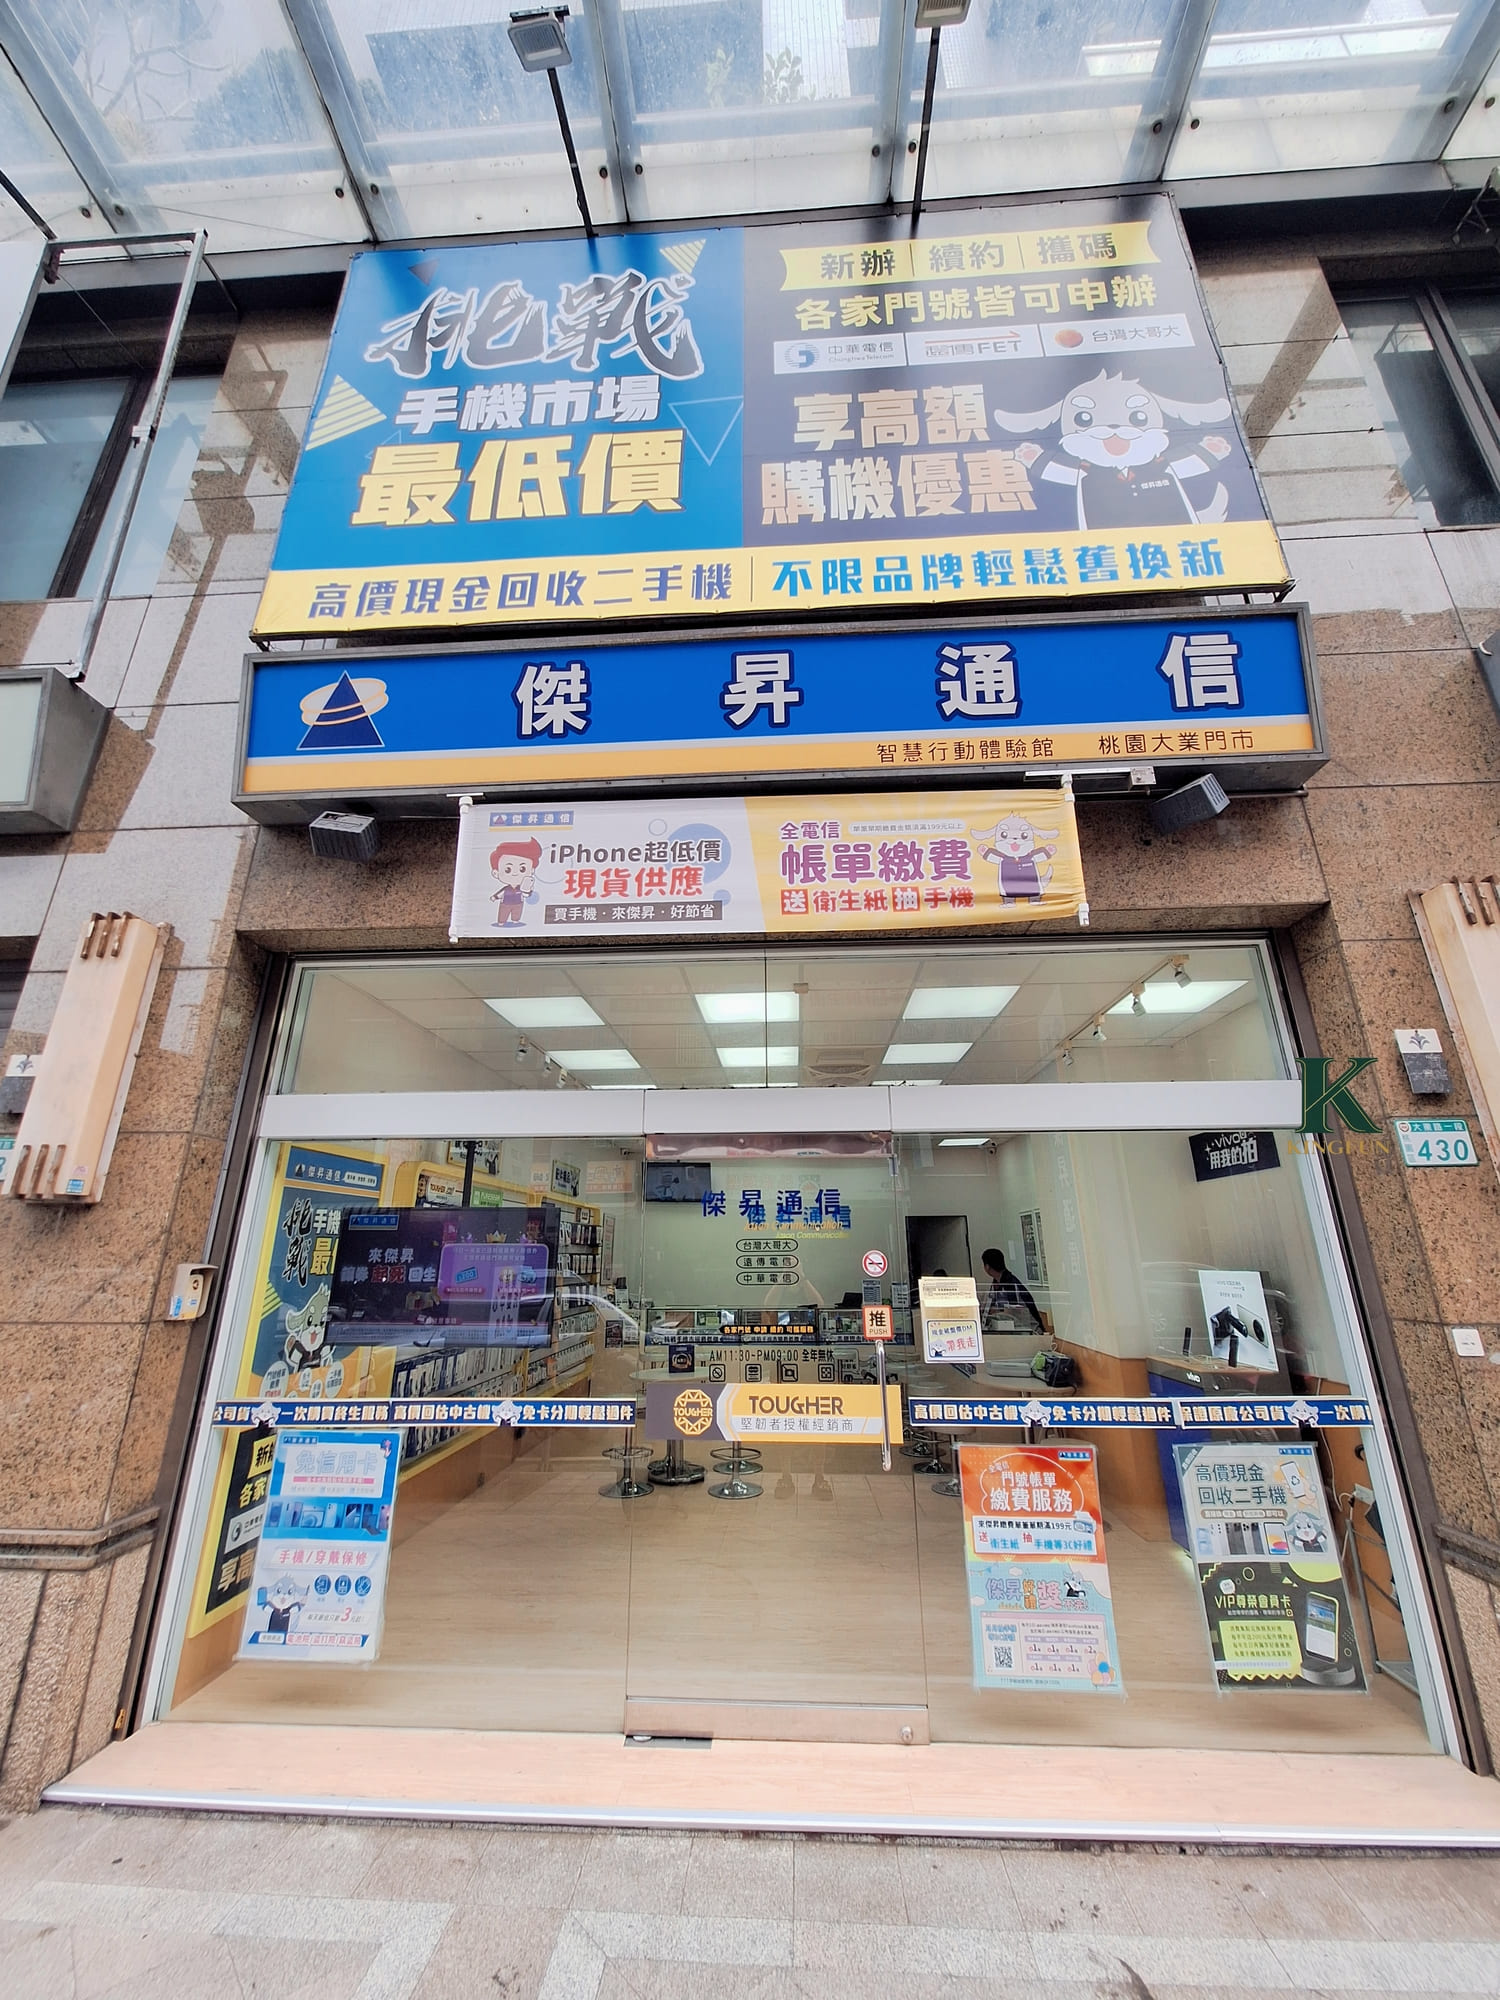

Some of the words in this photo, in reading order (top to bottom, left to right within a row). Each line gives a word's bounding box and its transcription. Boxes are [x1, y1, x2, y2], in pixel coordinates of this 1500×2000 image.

[820, 249, 896, 280] 新辦
[929, 240, 1004, 272] 續約
[1038, 232, 1116, 263] 攜碼
[795, 275, 1157, 331] 各家門號皆可申辦
[364, 268, 704, 380] 挑戰
[828, 342, 893, 355] 中華電信
[978, 340, 1021, 354] FET
[1092, 325, 1181, 344] 台灣大哥大
[395, 375, 660, 435] 手機市場
[794, 384, 990, 451] 享高額
[351, 429, 685, 527] 最低價
[761, 448, 1038, 525] 購機優惠
[308, 563, 733, 618] 高價現金回收二手機
[772, 539, 1226, 597] 不限品牌輕鬆舊換新
[516, 633, 1241, 735] 傑昇通信
[876, 737, 1055, 763] 智慧行動體驗館
[1098, 729, 1255, 754] 桃園大業門市
[512, 813, 570, 825] 傑昇通信
[780, 821, 840, 840] 全電信
[550, 839, 721, 864] iPhone超低價
[781, 839, 972, 884] 帳單繳費
[563, 867, 704, 899] 現貨供應
[1213, 1134, 1240, 1148] vivo
[1418, 1139, 1469, 1161] 430
[700, 1189, 840, 1217] 傑昇通信
[313, 1209, 341, 1234] 手機
[282, 1197, 313, 1287] 挑戰
[743, 1241, 791, 1250] 台灣大哥大
[743, 1257, 792, 1267] 遠傳電信
[743, 1274, 792, 1284] 中華電信
[869, 1310, 886, 1327] 推
[710, 1350, 799, 1362] AM11:30-PM09:00
[801, 1349, 835, 1362] 全年無休
[674, 1408, 712, 1417] TOUGHER
[749, 1396, 844, 1415] TOUGHER
[1320, 1405, 1371, 1421] 一次購
[741, 1418, 853, 1431] 堅韌者授權經銷商
[295, 1450, 377, 1475] 免信用卡
[1195, 1464, 1265, 1482] 高價現金
[1001, 1472, 1056, 1487] 門號帳單
[239, 1477, 267, 1508] 各家
[990, 1488, 1072, 1512] 繳費服務
[1199, 1486, 1287, 1505] 回收二手機
[979, 1532, 988, 1543] 送
[1022, 1532, 1032, 1543] 抽
[990, 1538, 1020, 1550] 衛生紙
[1214, 1594, 1292, 1609] VIP尊榮會員卡
